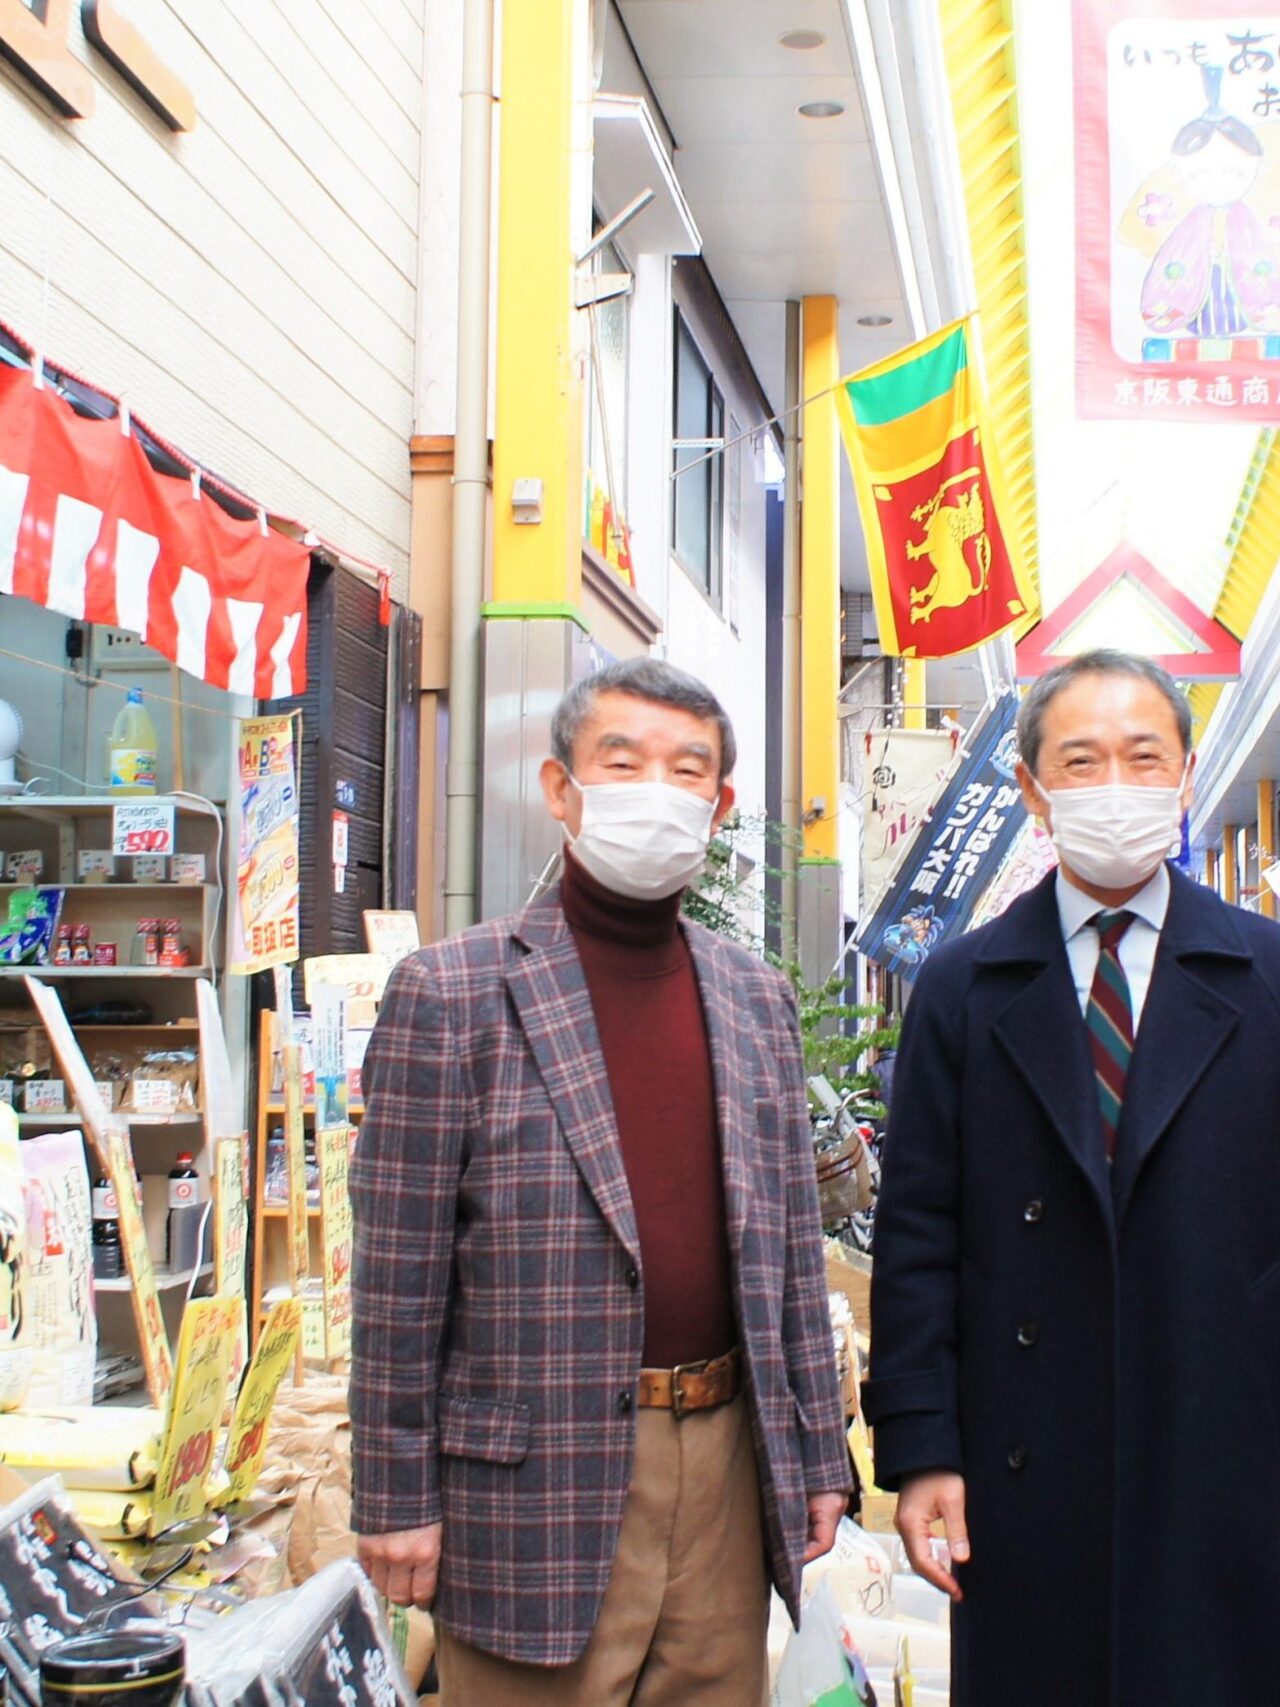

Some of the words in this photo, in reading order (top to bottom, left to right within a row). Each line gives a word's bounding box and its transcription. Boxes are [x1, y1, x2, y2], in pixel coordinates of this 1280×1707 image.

[1123, 39, 1211, 66] いつも
[910, 783, 992, 895] ガンバ大阪
